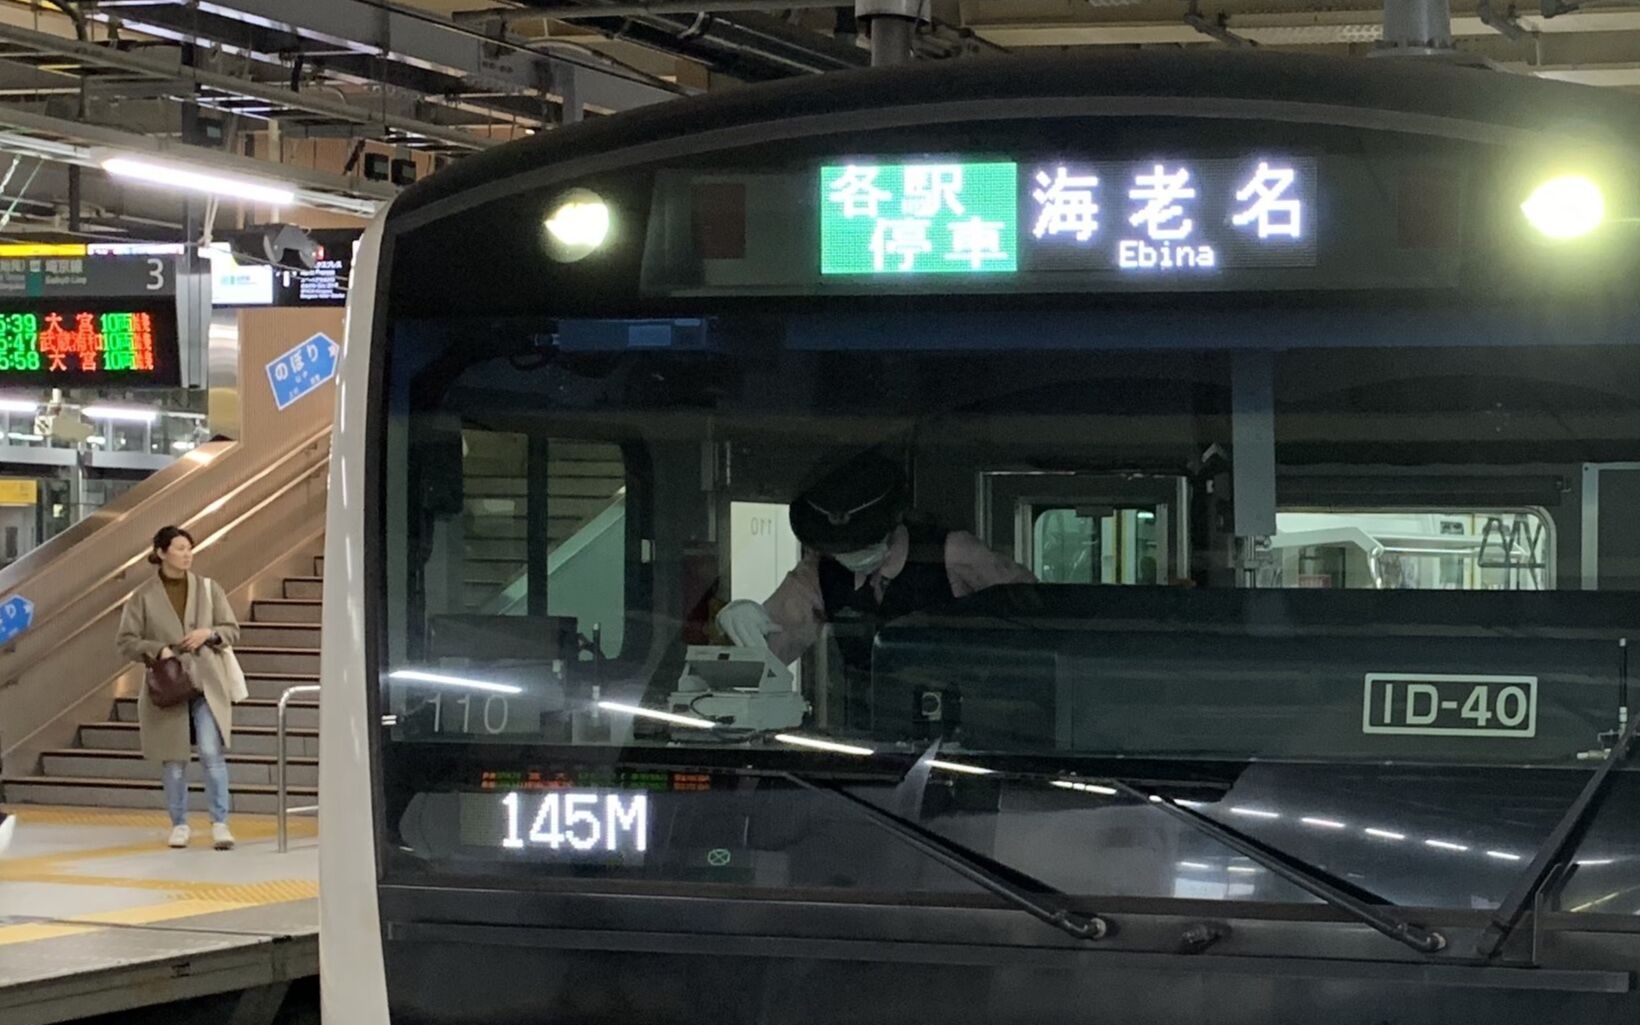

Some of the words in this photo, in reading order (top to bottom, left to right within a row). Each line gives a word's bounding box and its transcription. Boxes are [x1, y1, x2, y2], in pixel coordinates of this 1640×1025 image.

[829, 165, 966, 219] 各駅
[1033, 162, 1303, 241] 海老名
[869, 217, 1009, 271] 停車
[1119, 240, 1216, 268] Ebina
[146, 258, 165, 290] 3
[275, 344, 319, 381] のぼり
[428, 692, 509, 735] 110
[1384, 683, 1527, 727] ID-40
[502, 792, 647, 851] 145M
